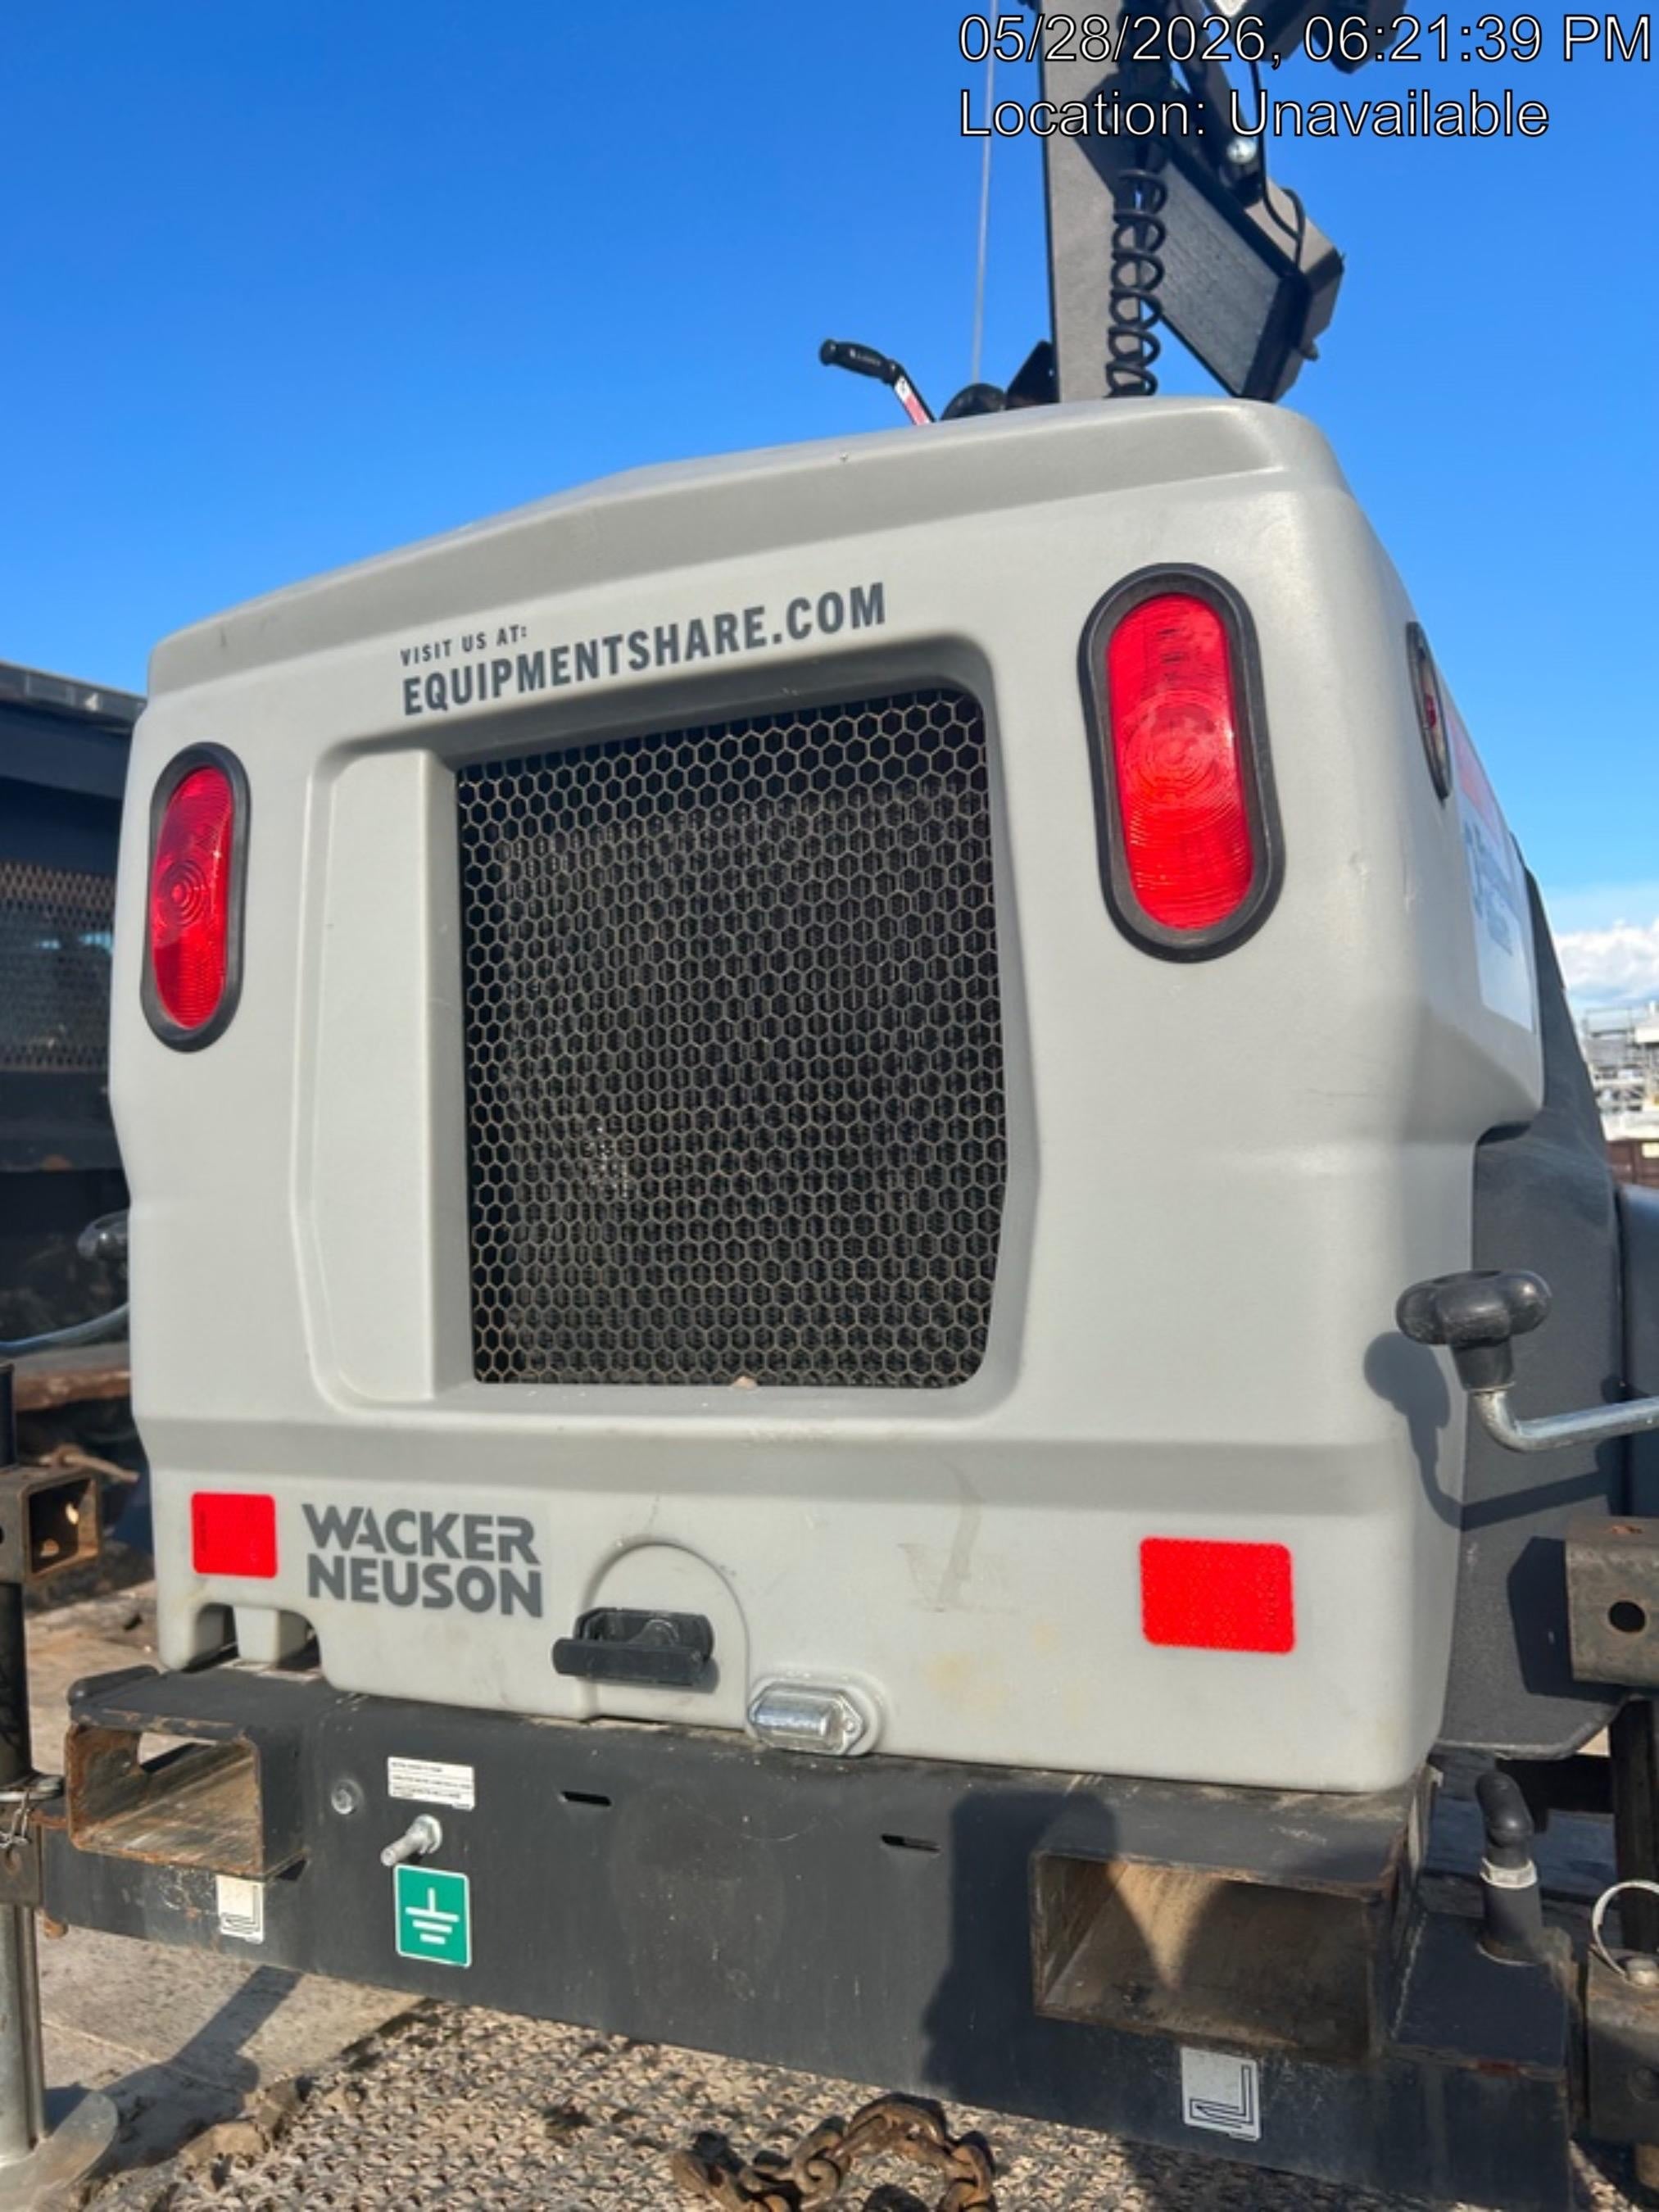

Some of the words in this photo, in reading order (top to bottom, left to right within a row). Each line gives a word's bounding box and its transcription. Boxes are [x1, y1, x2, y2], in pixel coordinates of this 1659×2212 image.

[401, 639, 452, 666] VISIT
[463, 632, 487, 652] US
[496, 625, 527, 646] AT:
[403, 582, 886, 715] EQUIPMENTSHARE.COM
[301, 1503, 541, 1565] WACKER
[307, 1553, 542, 1618] NEUSON
